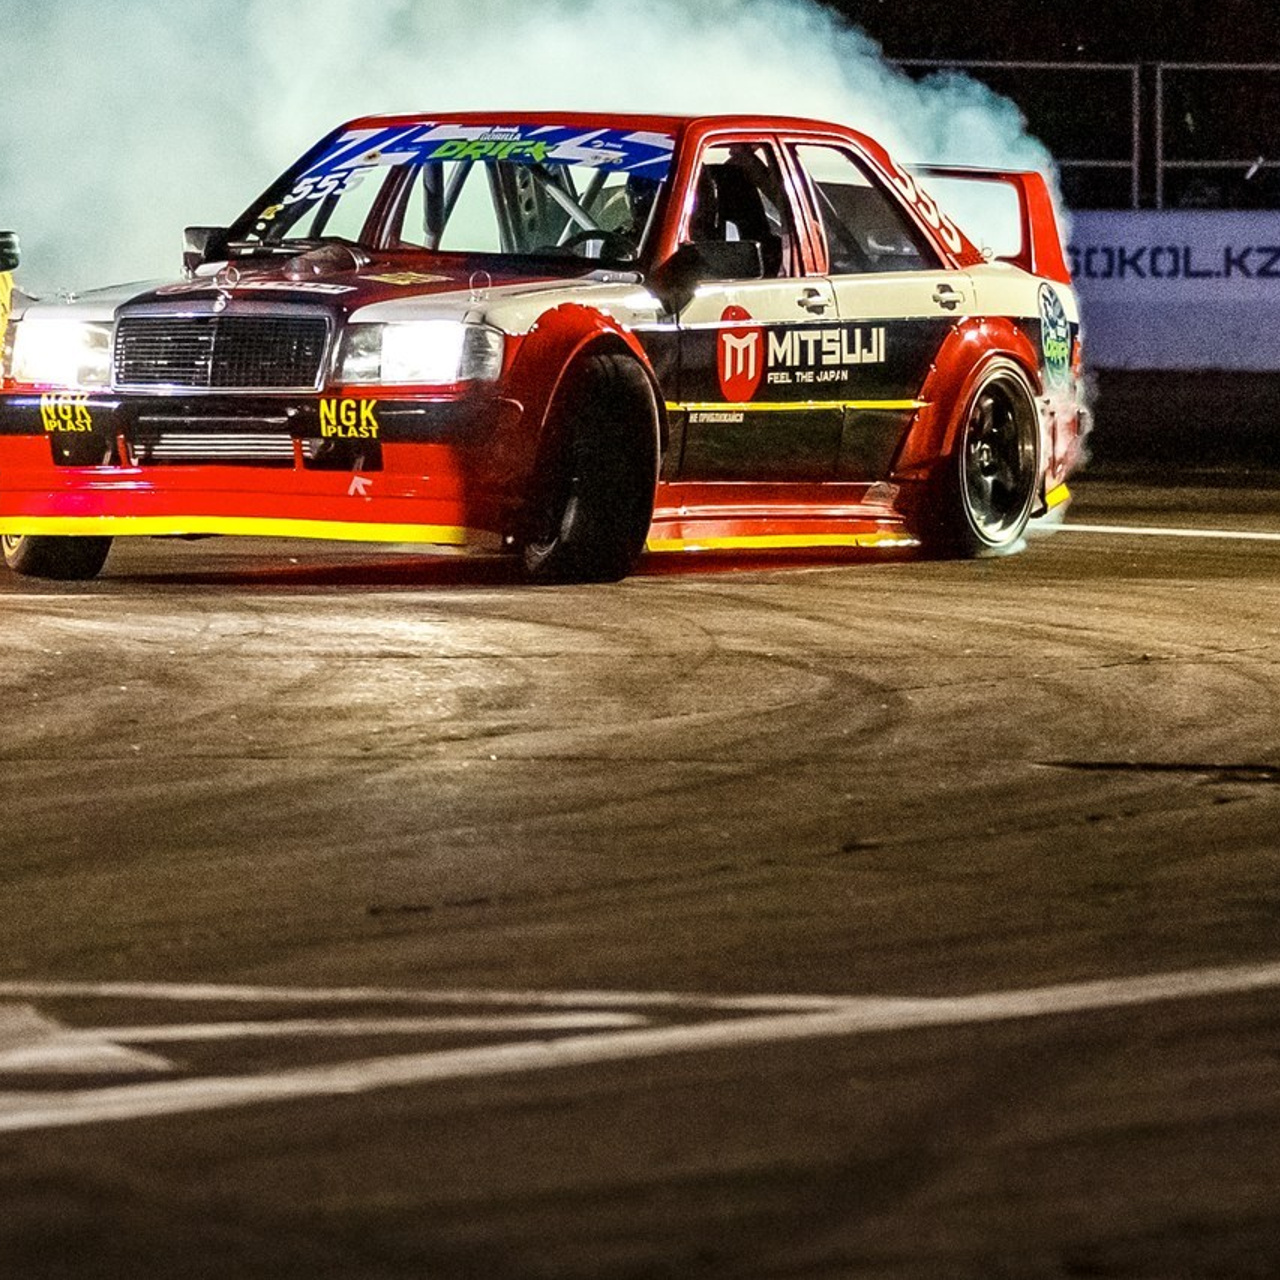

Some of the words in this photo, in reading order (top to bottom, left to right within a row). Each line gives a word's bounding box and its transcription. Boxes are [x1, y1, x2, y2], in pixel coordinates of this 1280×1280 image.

[768, 327, 886, 367] MITSUJI
[767, 371, 792, 384] FEEL
[795, 371, 814, 383] THE
[816, 369, 849, 382] JAPAN
[40, 392, 92, 423] NGK
[320, 398, 378, 428] NGK
[49, 419, 92, 432] PLAST
[327, 425, 379, 438] PLAST
